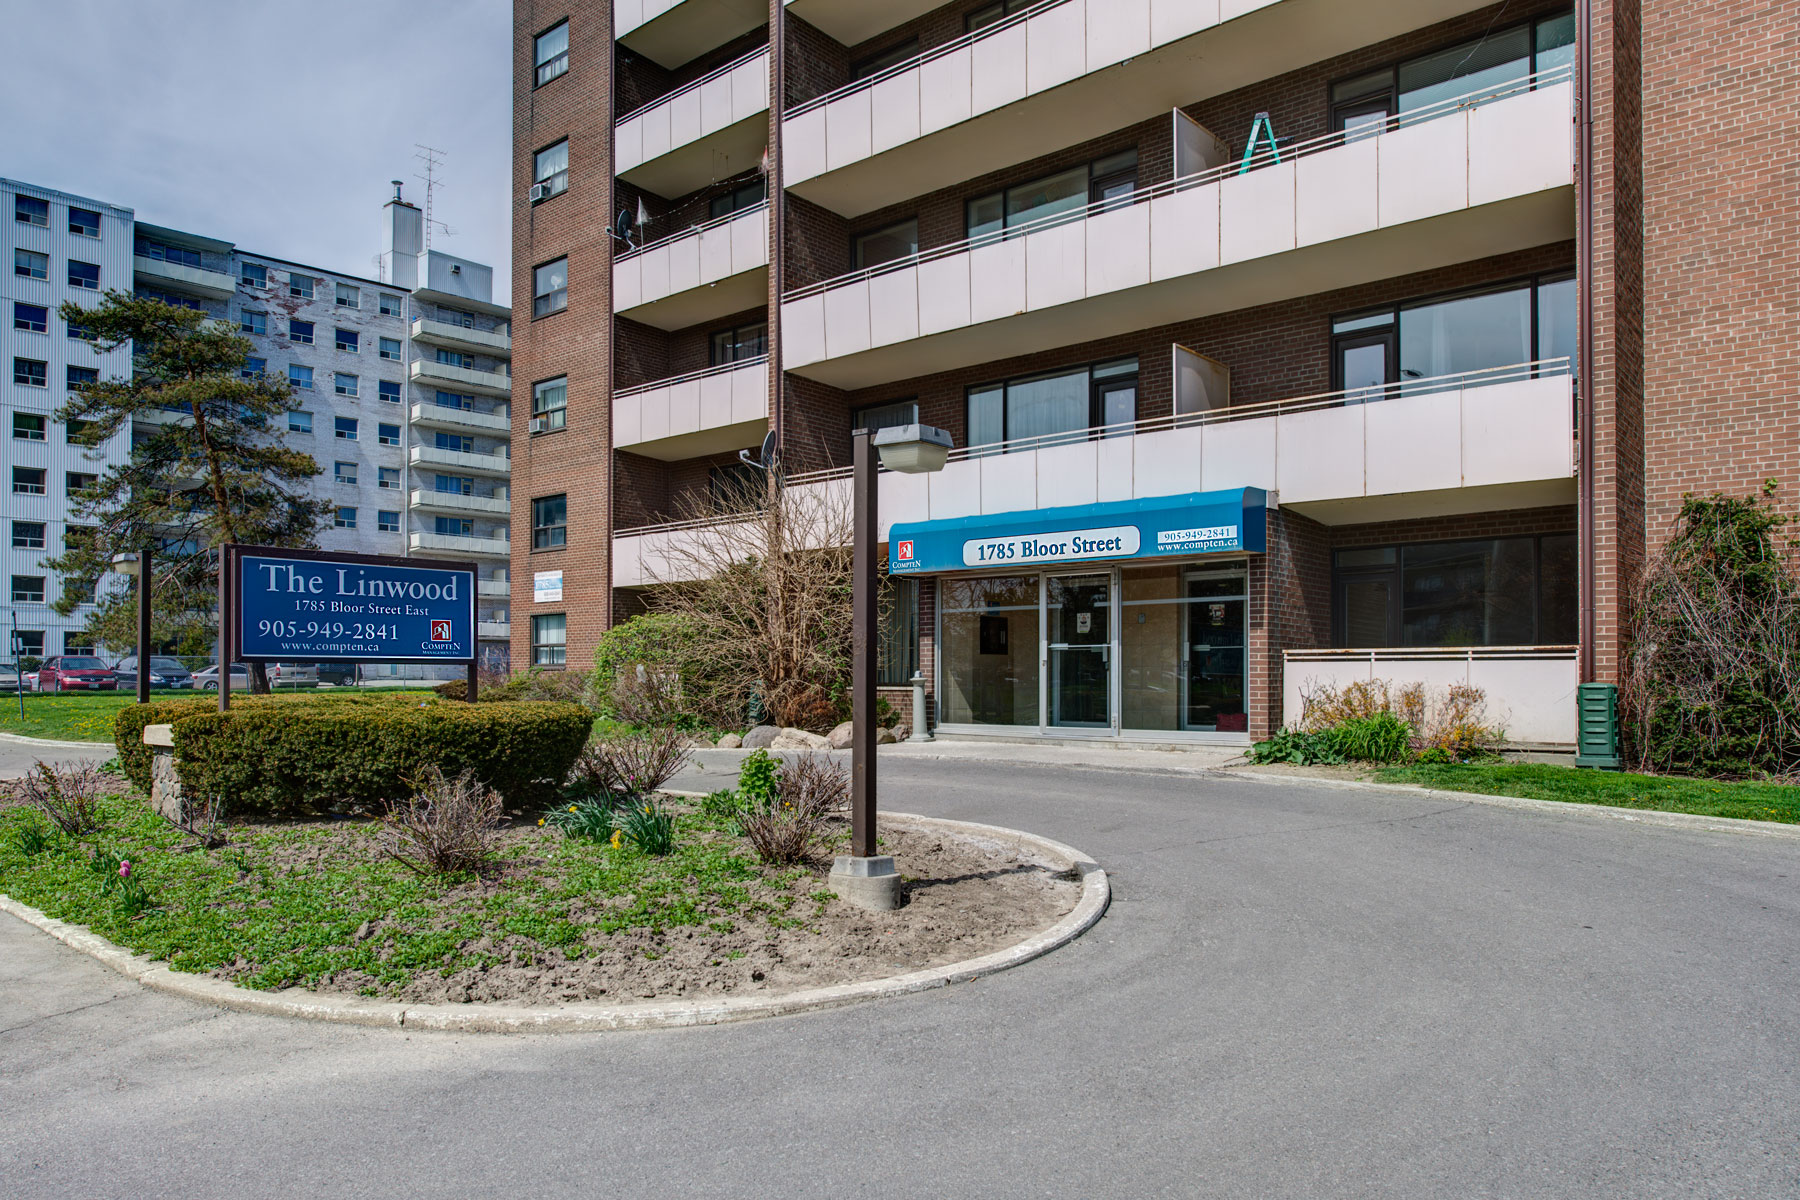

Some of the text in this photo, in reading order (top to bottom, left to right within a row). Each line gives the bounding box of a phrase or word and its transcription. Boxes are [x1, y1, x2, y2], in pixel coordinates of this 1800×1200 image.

[1164, 528, 1230, 541] 905-949-2841
[978, 536, 1122, 560] 1785 Bloor Street
[1157, 538, 1238, 551] www.compten.ca
[259, 563, 458, 601] The Linwood
[295, 600, 429, 616] 1785 Bloor Street East
[259, 620, 399, 640] 905-949-2841
[281, 641, 379, 652] www.compten.ca
[422, 642, 460, 650] COMPTEN
